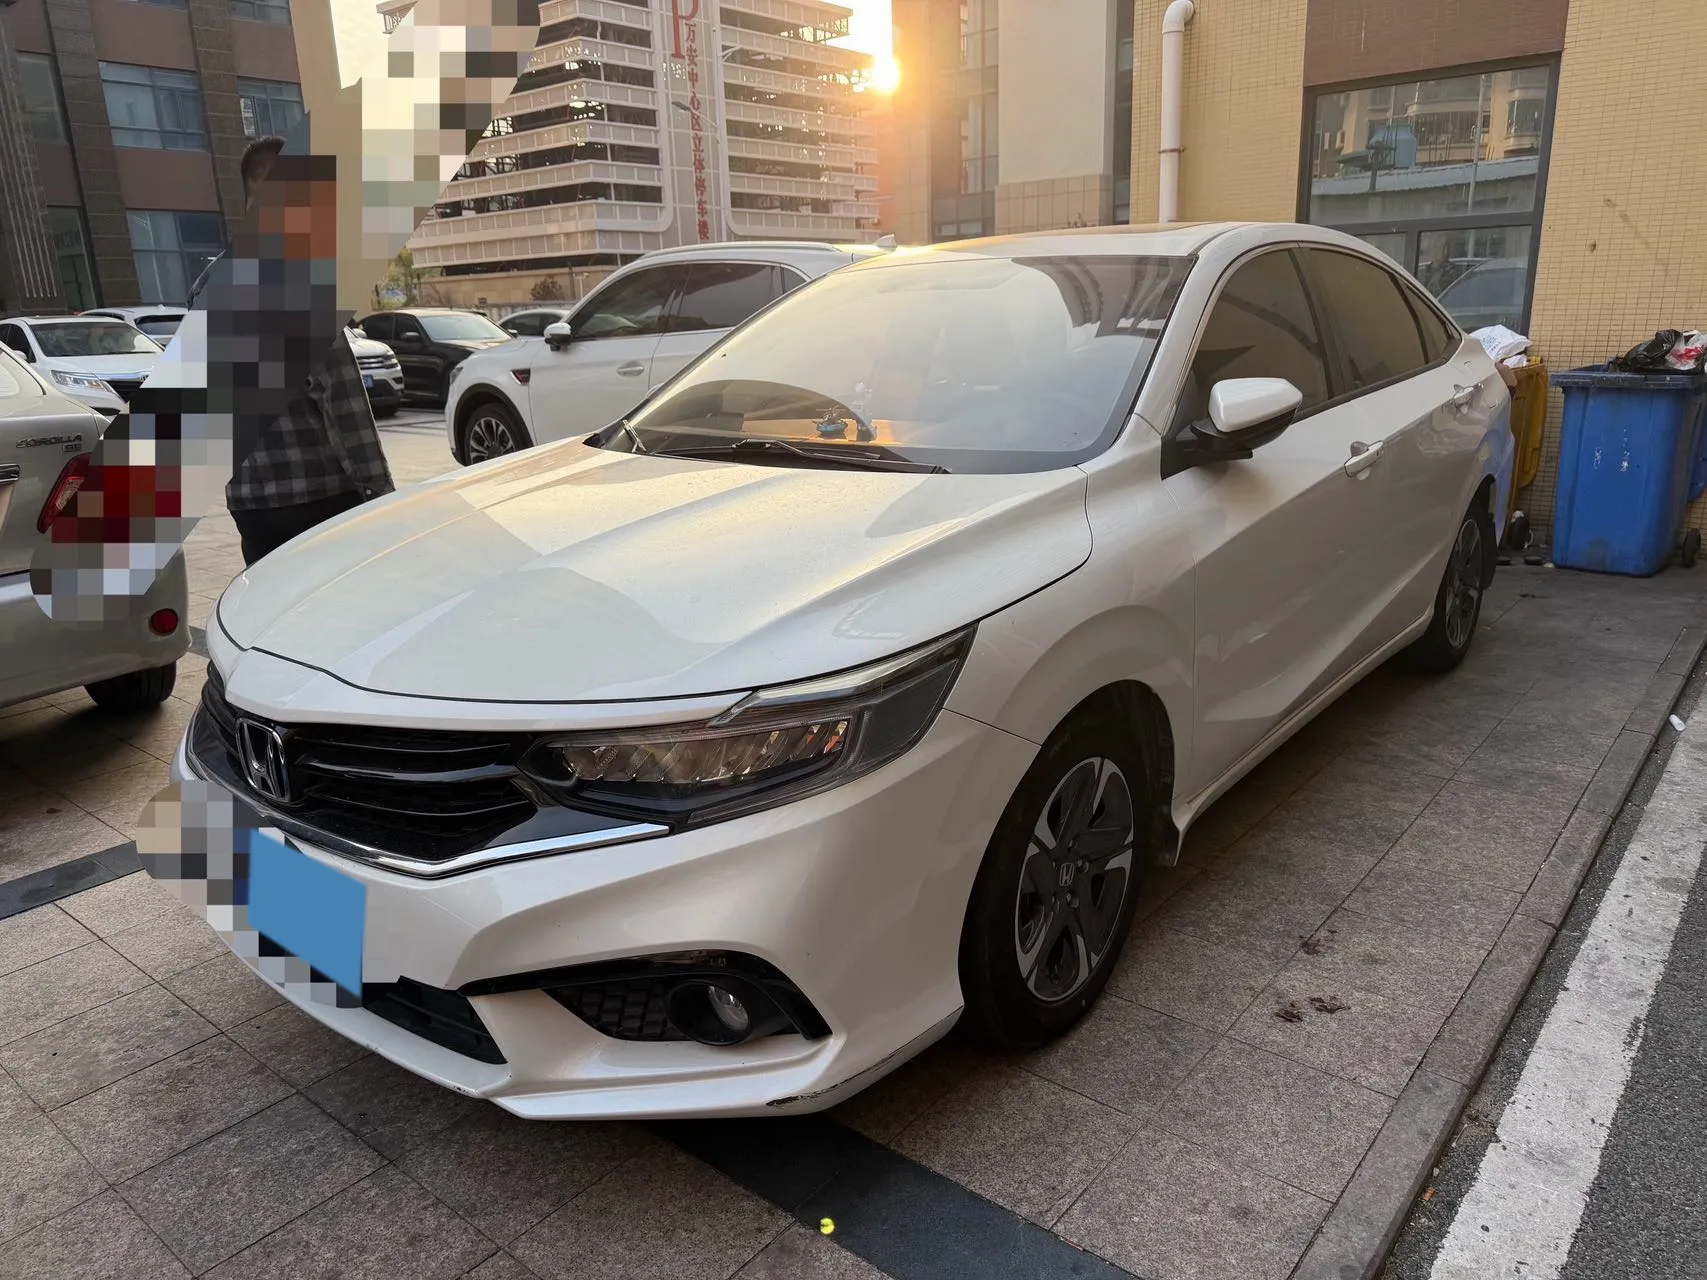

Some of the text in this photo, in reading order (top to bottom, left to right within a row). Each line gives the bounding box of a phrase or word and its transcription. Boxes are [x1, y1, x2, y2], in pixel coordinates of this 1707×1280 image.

[684, 22, 709, 240] 万安中心区立体停车楼
